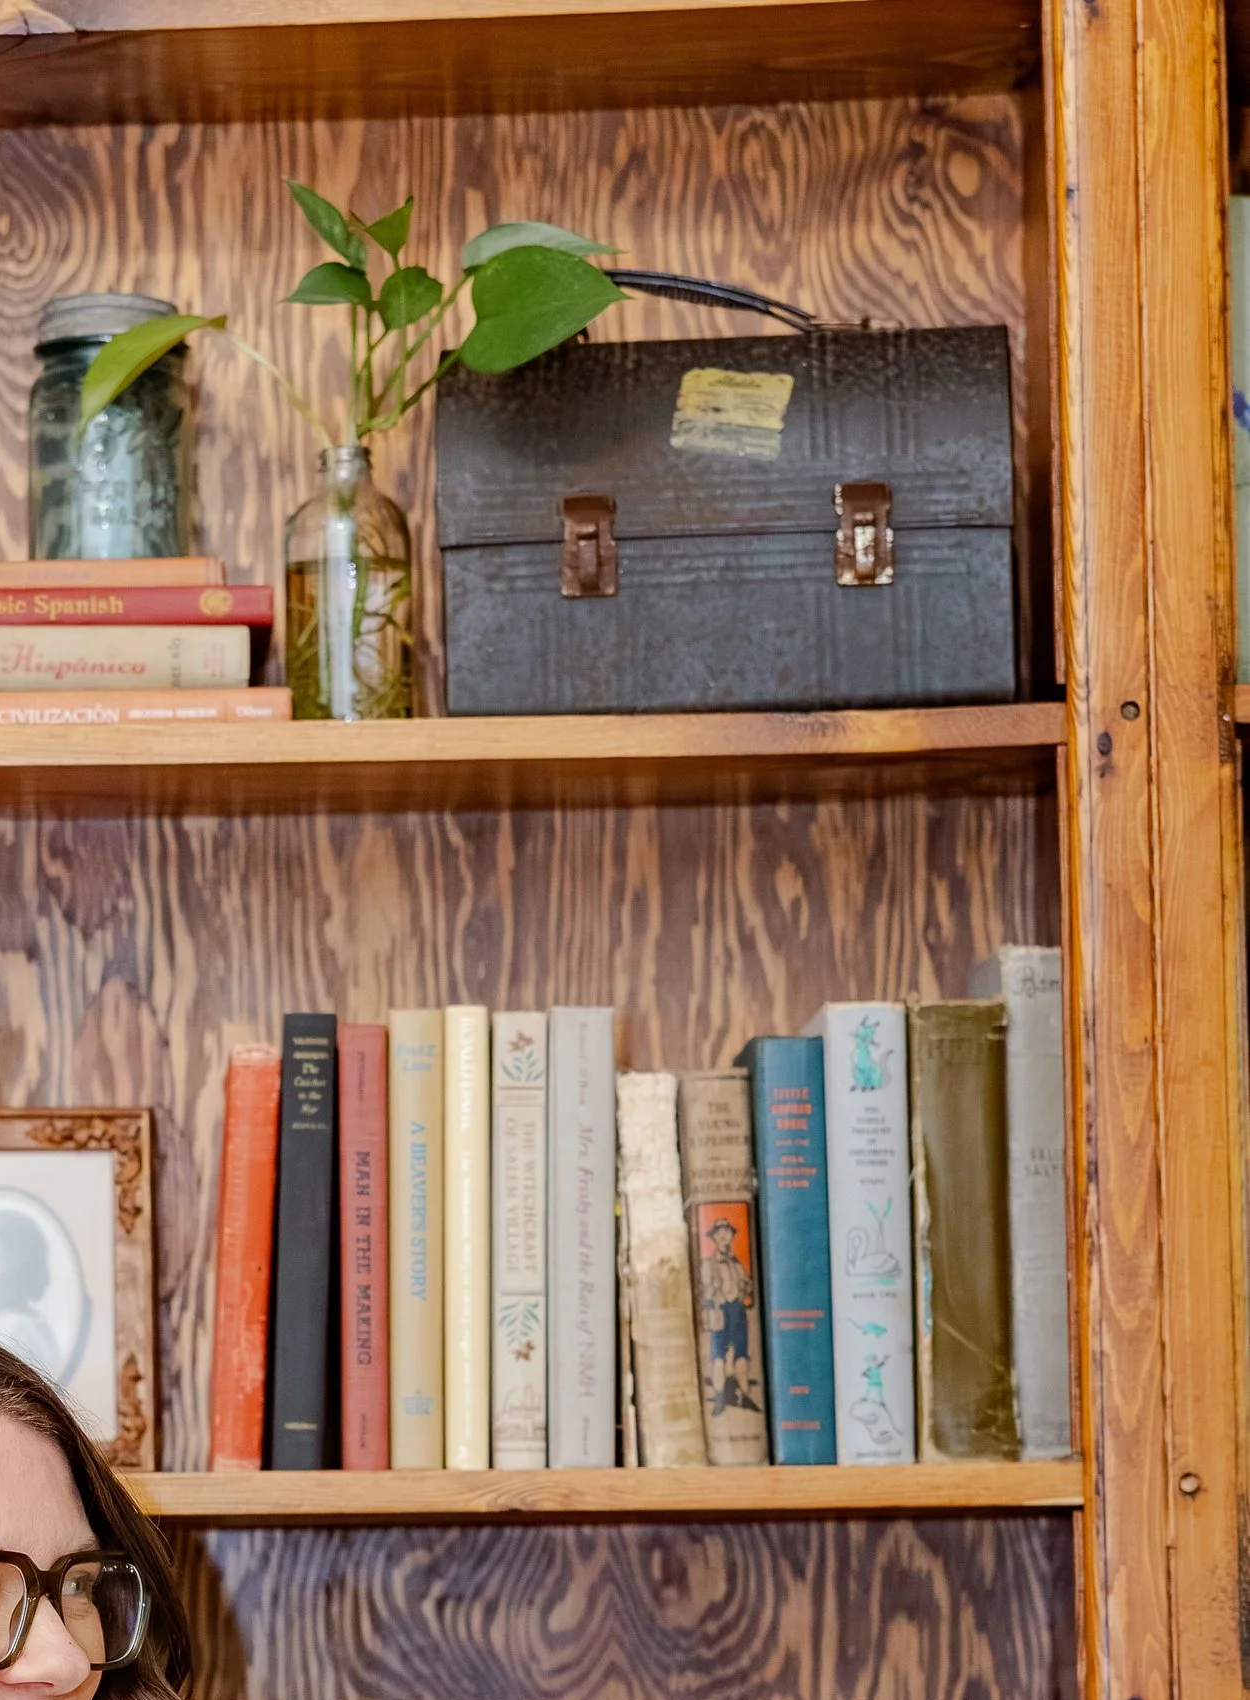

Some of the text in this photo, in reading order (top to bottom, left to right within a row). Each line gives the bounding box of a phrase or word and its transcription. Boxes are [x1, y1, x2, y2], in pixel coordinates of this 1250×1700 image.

[33, 594, 125, 620] Spanish
[0, 642, 146, 679] Hispánico
[411, 1122, 426, 1135] A
[522, 1160, 538, 1273] WITCHCRAFT
[578, 1218, 595, 1250] and
[356, 1151, 373, 1366] MAN IN THE MAKING
[410, 1237, 428, 1301] STORY
[578, 1254, 595, 1276] the
